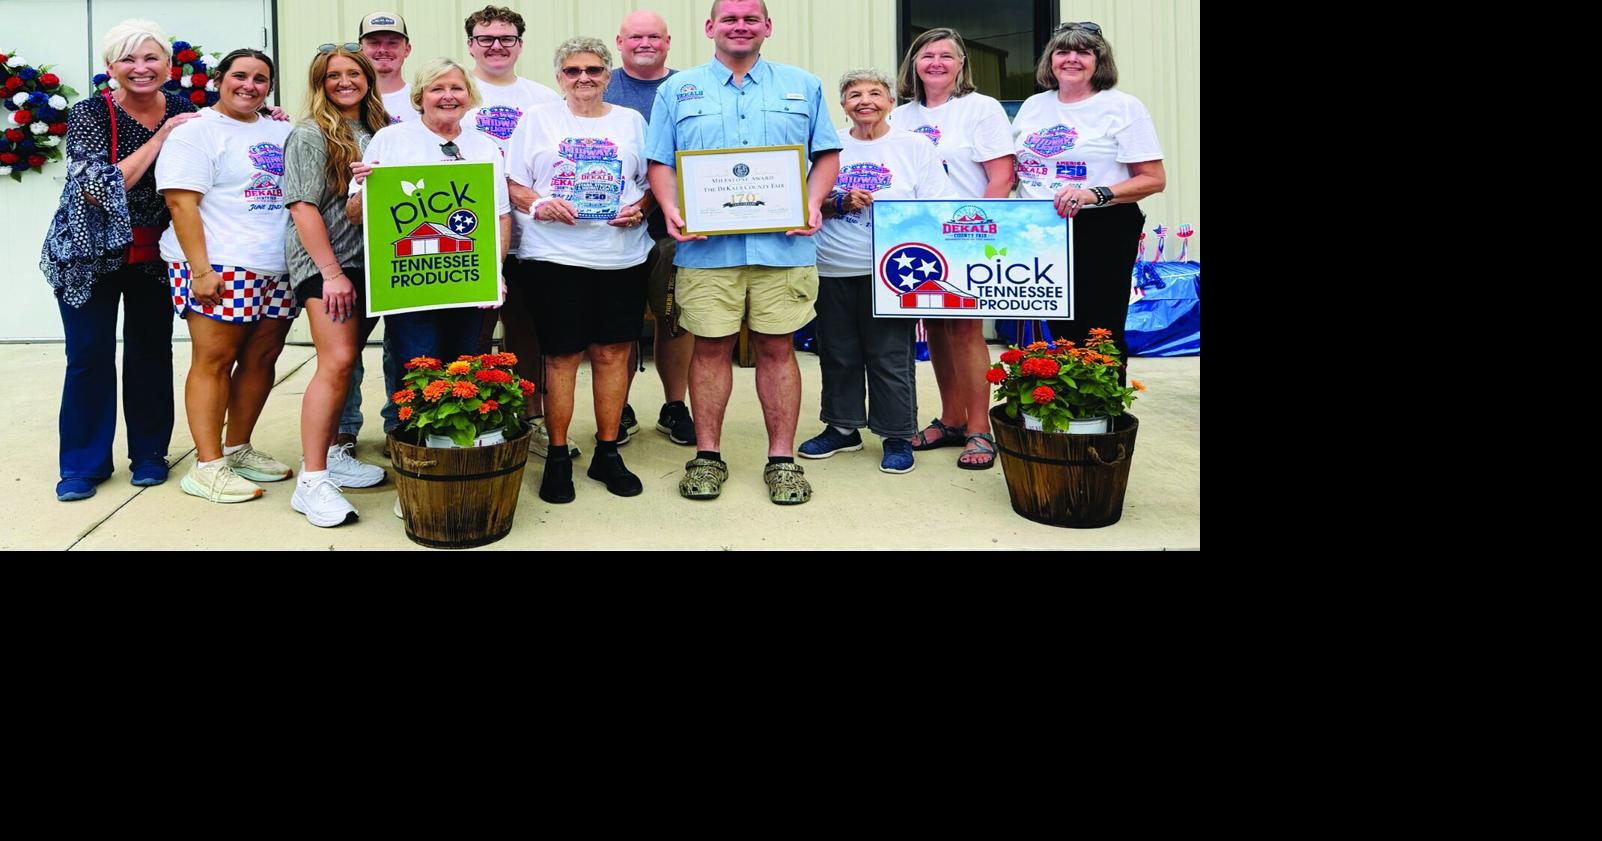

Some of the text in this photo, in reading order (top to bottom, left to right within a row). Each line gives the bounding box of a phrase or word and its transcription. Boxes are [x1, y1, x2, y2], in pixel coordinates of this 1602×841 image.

[1056, 165, 1087, 176] 250
[244, 189, 283, 198] DEKALB
[731, 192, 756, 203] 170
[390, 180, 477, 234] pick
[942, 223, 997, 234] DEKALB
[391, 254, 480, 273] TENNESSEE
[390, 268, 480, 289] PRODUCTS
[966, 256, 1055, 291] pick
[976, 285, 1063, 299] TENNESSEE
[979, 299, 1058, 311] PRODUCTS
